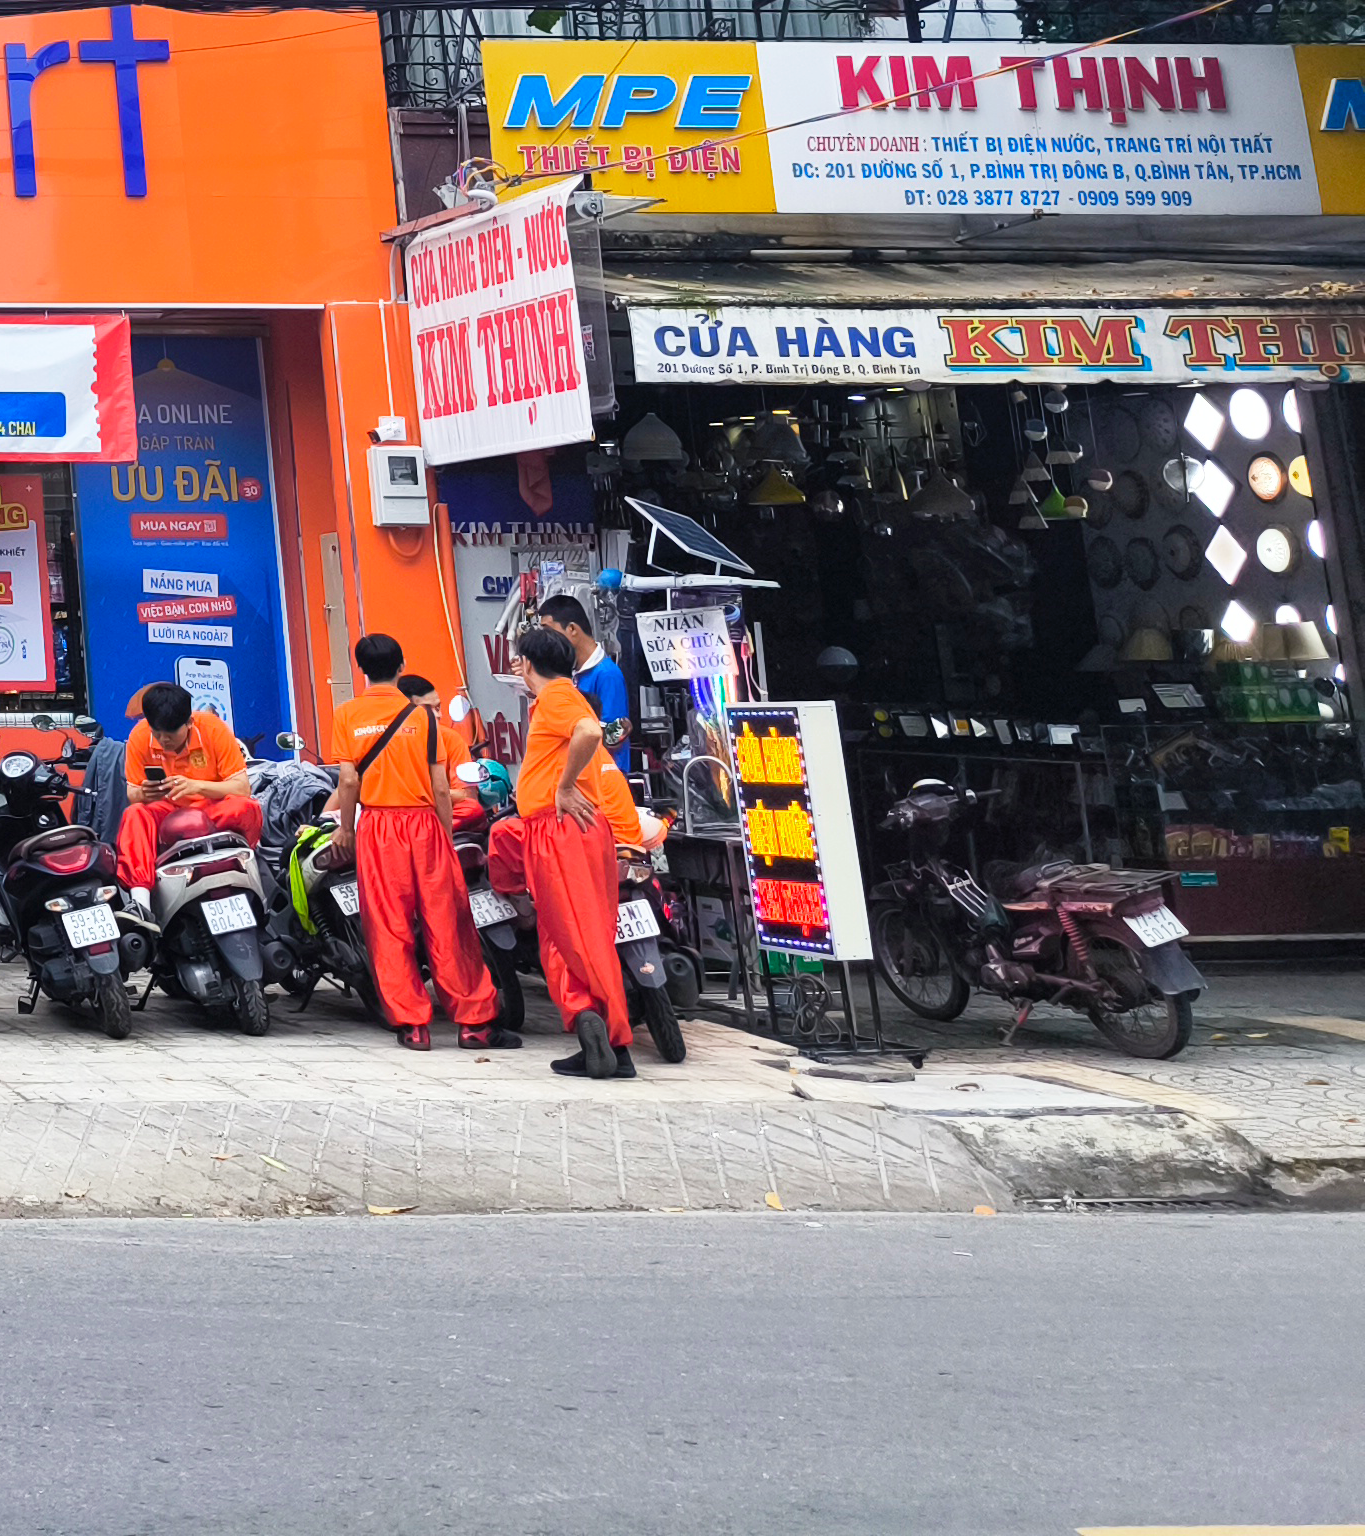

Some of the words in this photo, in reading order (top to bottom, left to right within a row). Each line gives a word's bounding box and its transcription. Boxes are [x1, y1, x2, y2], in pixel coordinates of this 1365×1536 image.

[503, 73, 753, 129] MPE
[835, 54, 978, 111] KIM
[997, 55, 1228, 125] THỊNH
[807, 132, 866, 152] CHUYÊN
[870, 136, 920, 152] DOANH
[931, 131, 979, 153] THIẾT
[985, 137, 1004, 156] BỊ
[1007, 133, 1047, 156] ĐIỆN
[1051, 132, 1101, 156] NƯỚC,
[1104, 137, 1162, 154] TRANG
[1164, 133, 1192, 154] TRÍ
[1198, 134, 1226, 156] NỘI
[1230, 132, 1273, 154] THẤT
[517, 134, 611, 173] THIẾT
[665, 139, 741, 180] ĐIỆN
[792, 162, 820, 179] ĐC:
[825, 163, 856, 179] 201
[861, 158, 918, 179] ĐƯỜNG
[921, 157, 944, 179] SỐ
[970, 160, 1026, 180] P.BÌNH
[1029, 163, 1058, 183] TRỊ
[1062, 160, 1109, 180] ĐÔNG
[1135, 160, 1191, 183] Q.BÌNH
[1238, 164, 1302, 181] TP.HCM
[904, 189, 932, 206] ĐT:
[936, 189, 969, 206] 028
[974, 189, 1013, 206] 3877
[1020, 189, 1060, 206] 8727
[1077, 190, 1119, 206] 0909
[1125, 190, 1156, 206] 599
[1161, 190, 1192, 207] 909
[477, 216, 515, 298] ĐIỆN
[524, 195, 570, 276] NƯỚC
[653, 313, 760, 358] CỬA
[775, 317, 917, 359] HÀNG
[937, 315, 1152, 371] KIM
[416, 316, 478, 422] KIM
[477, 287, 582, 426] THỊNH
[657, 363, 679, 374] 201
[157, 403, 233, 424] ONLINE
[8, 420, 37, 436] CHAI
[110, 459, 164, 502] ƯU
[173, 459, 239, 502] ĐÃI
[140, 520, 168, 531] MUA
[169, 520, 202, 531] NGAY
[186, 578, 213, 593] MƯA
[653, 613, 705, 634] NHẬN
[185, 679, 225, 692] OneLife
[207, 897, 246, 915] 50-AC
[72, 922, 117, 945] 645.33
[211, 911, 255, 934] 804.13
